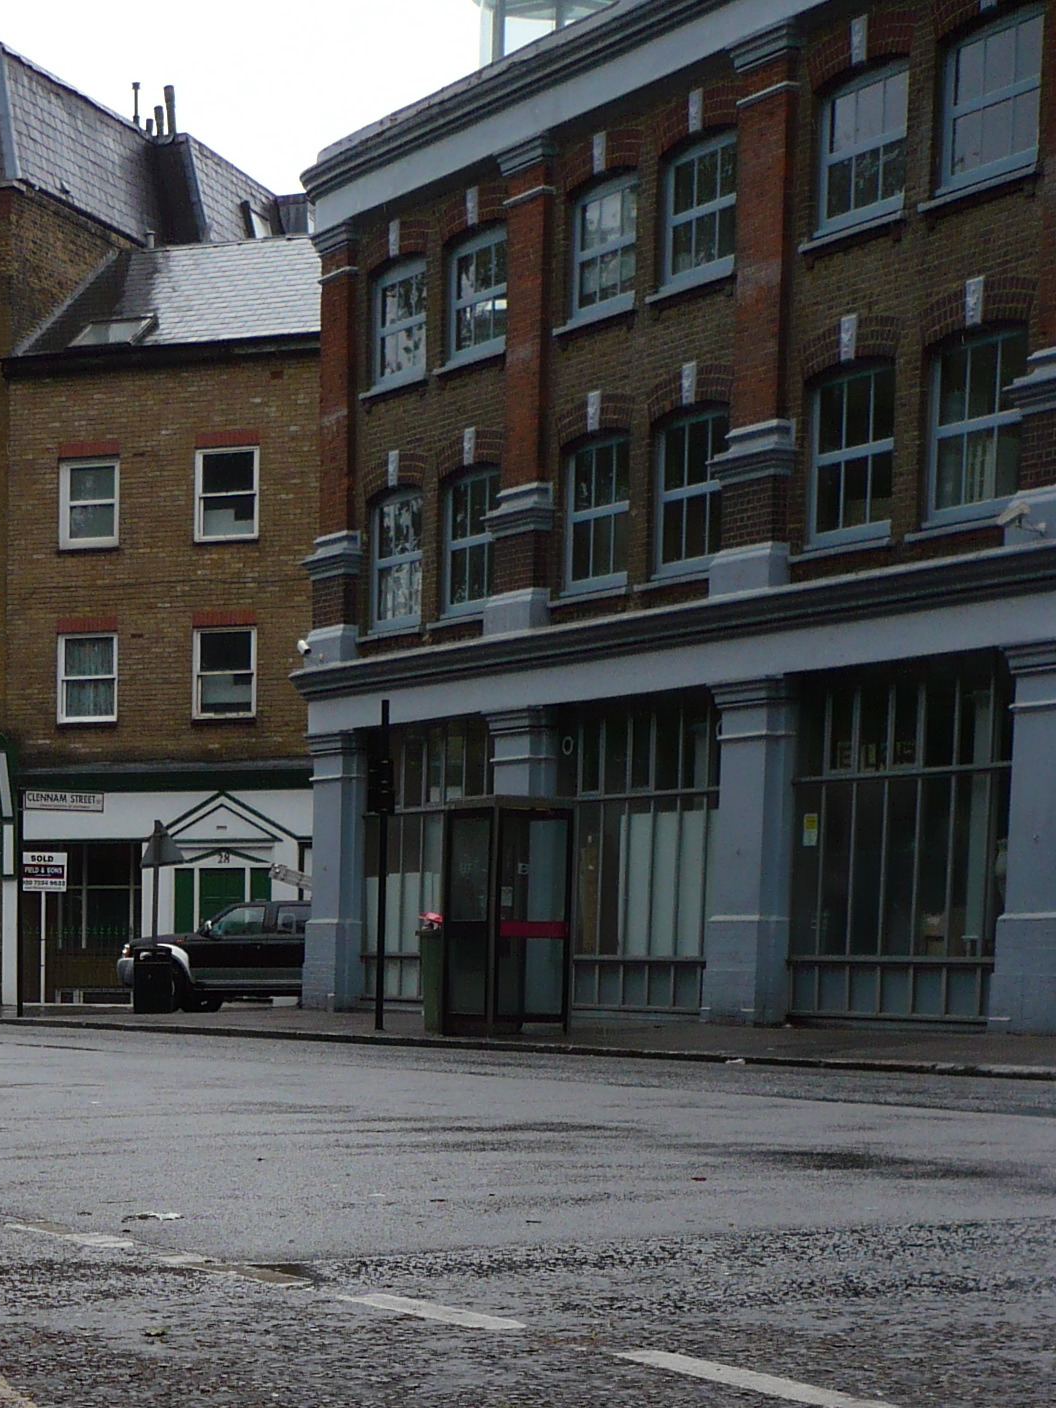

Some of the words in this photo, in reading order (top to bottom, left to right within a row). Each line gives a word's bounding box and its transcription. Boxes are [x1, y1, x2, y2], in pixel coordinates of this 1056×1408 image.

[27, 792, 67, 803] CLENNAM
[70, 794, 97, 804] STREET
[30, 855, 54, 863] SOLD
[217, 853, 230, 863] 28
